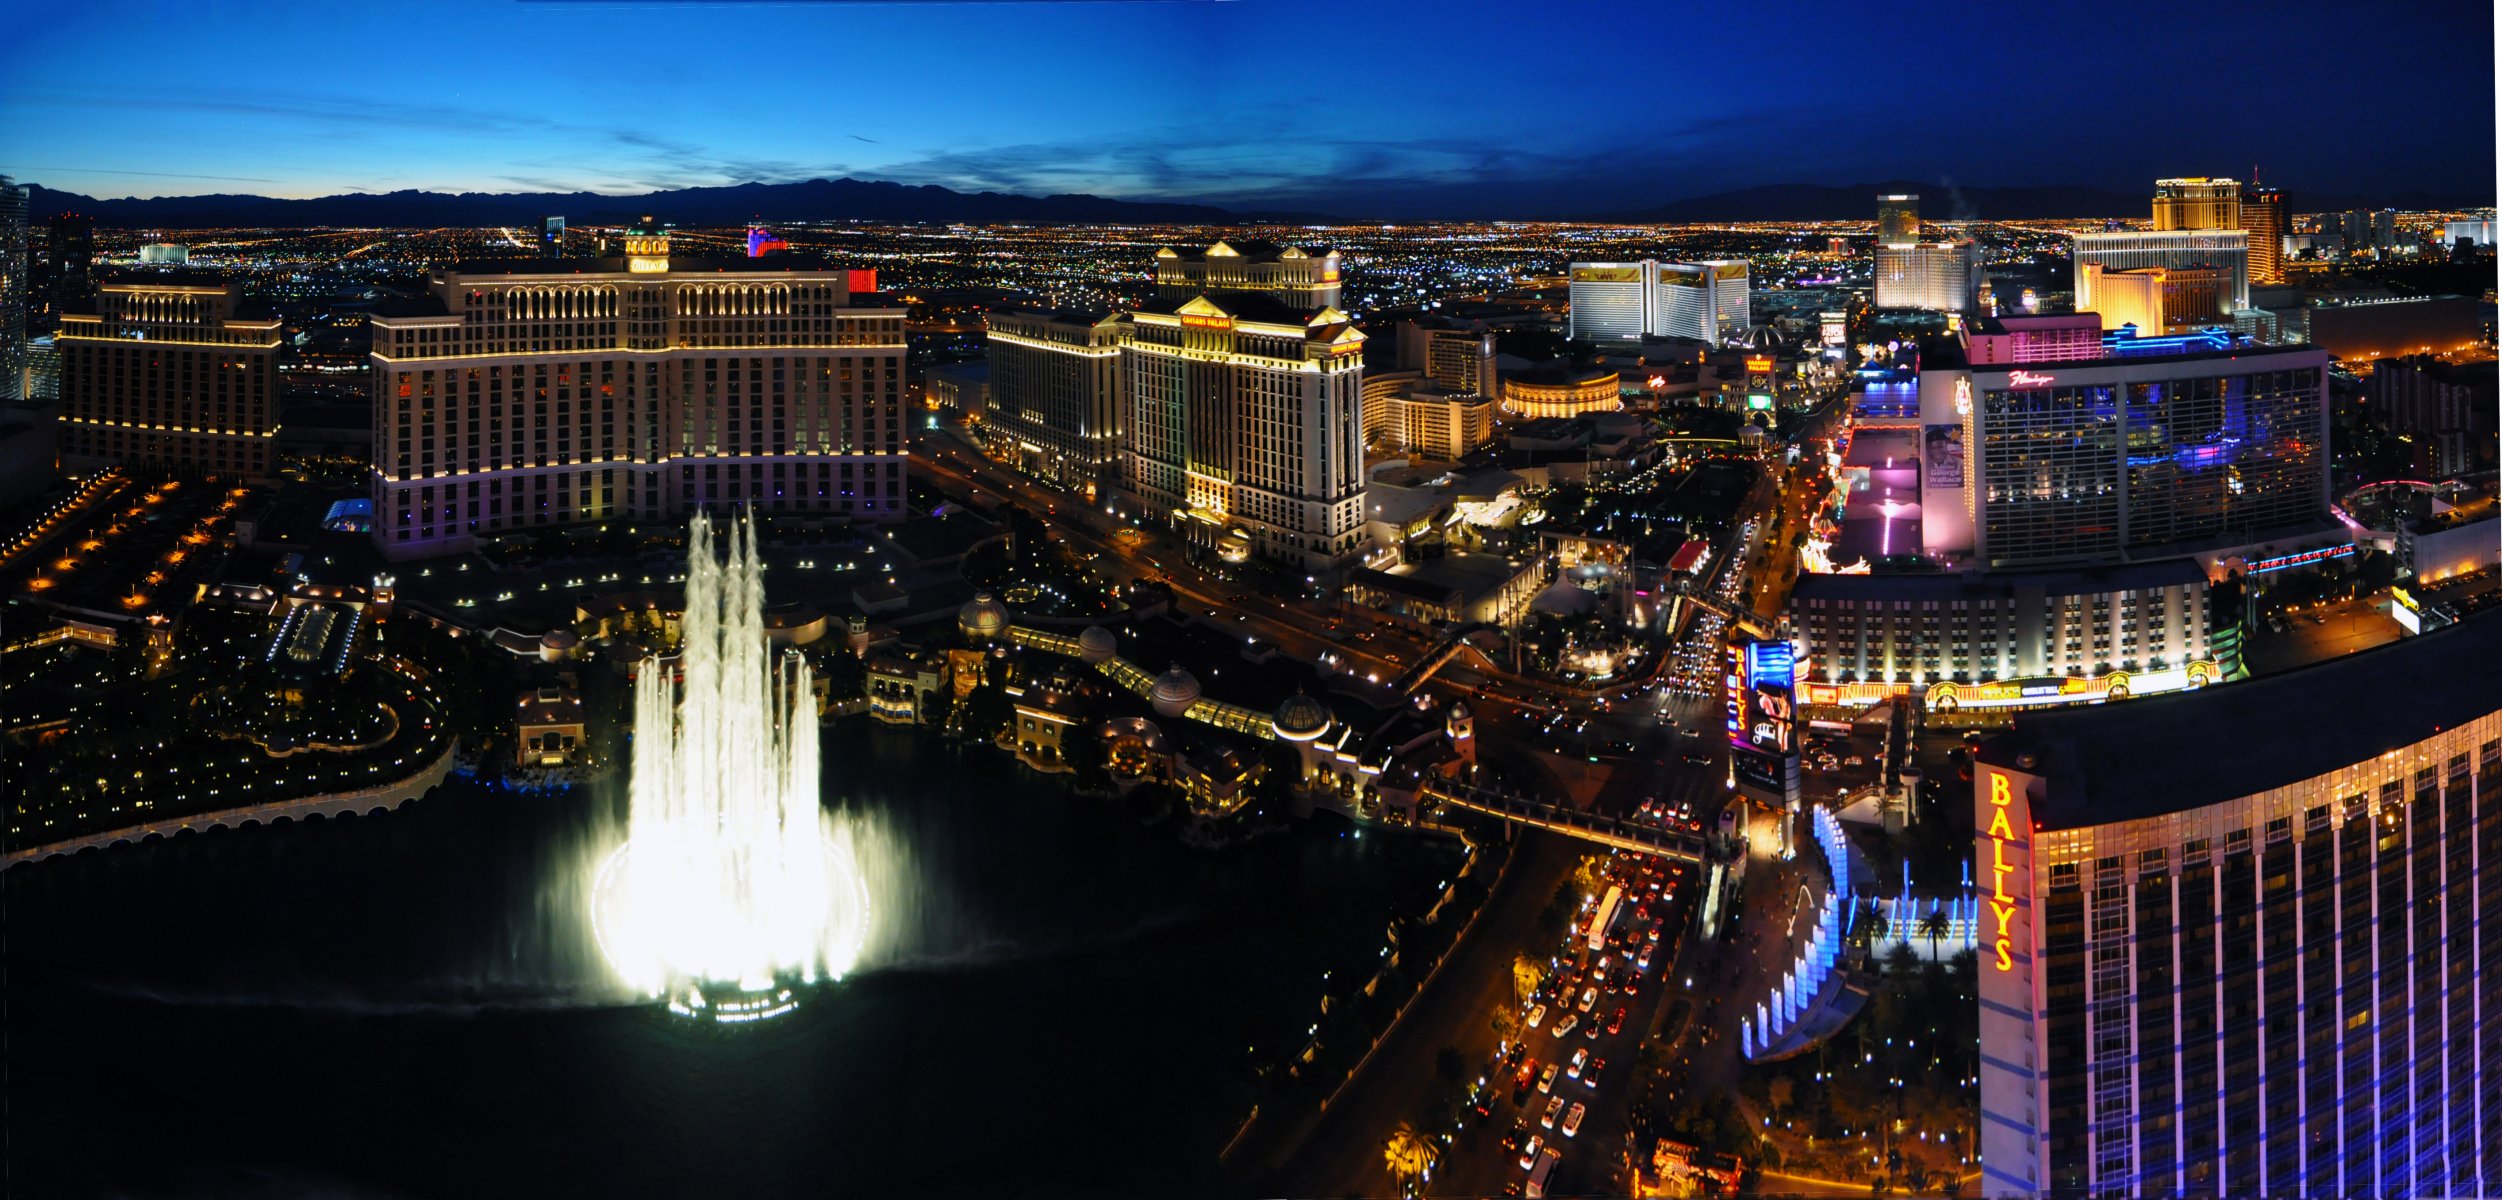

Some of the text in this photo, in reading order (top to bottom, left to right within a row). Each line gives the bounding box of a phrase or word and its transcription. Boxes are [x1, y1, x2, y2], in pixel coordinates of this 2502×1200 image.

[1183, 315, 1230, 329] CAESARS PALACE
[2008, 370, 2054, 387] Flamingo
[1930, 469, 1960, 477] George
[1988, 772, 2016, 972] BALLYS
